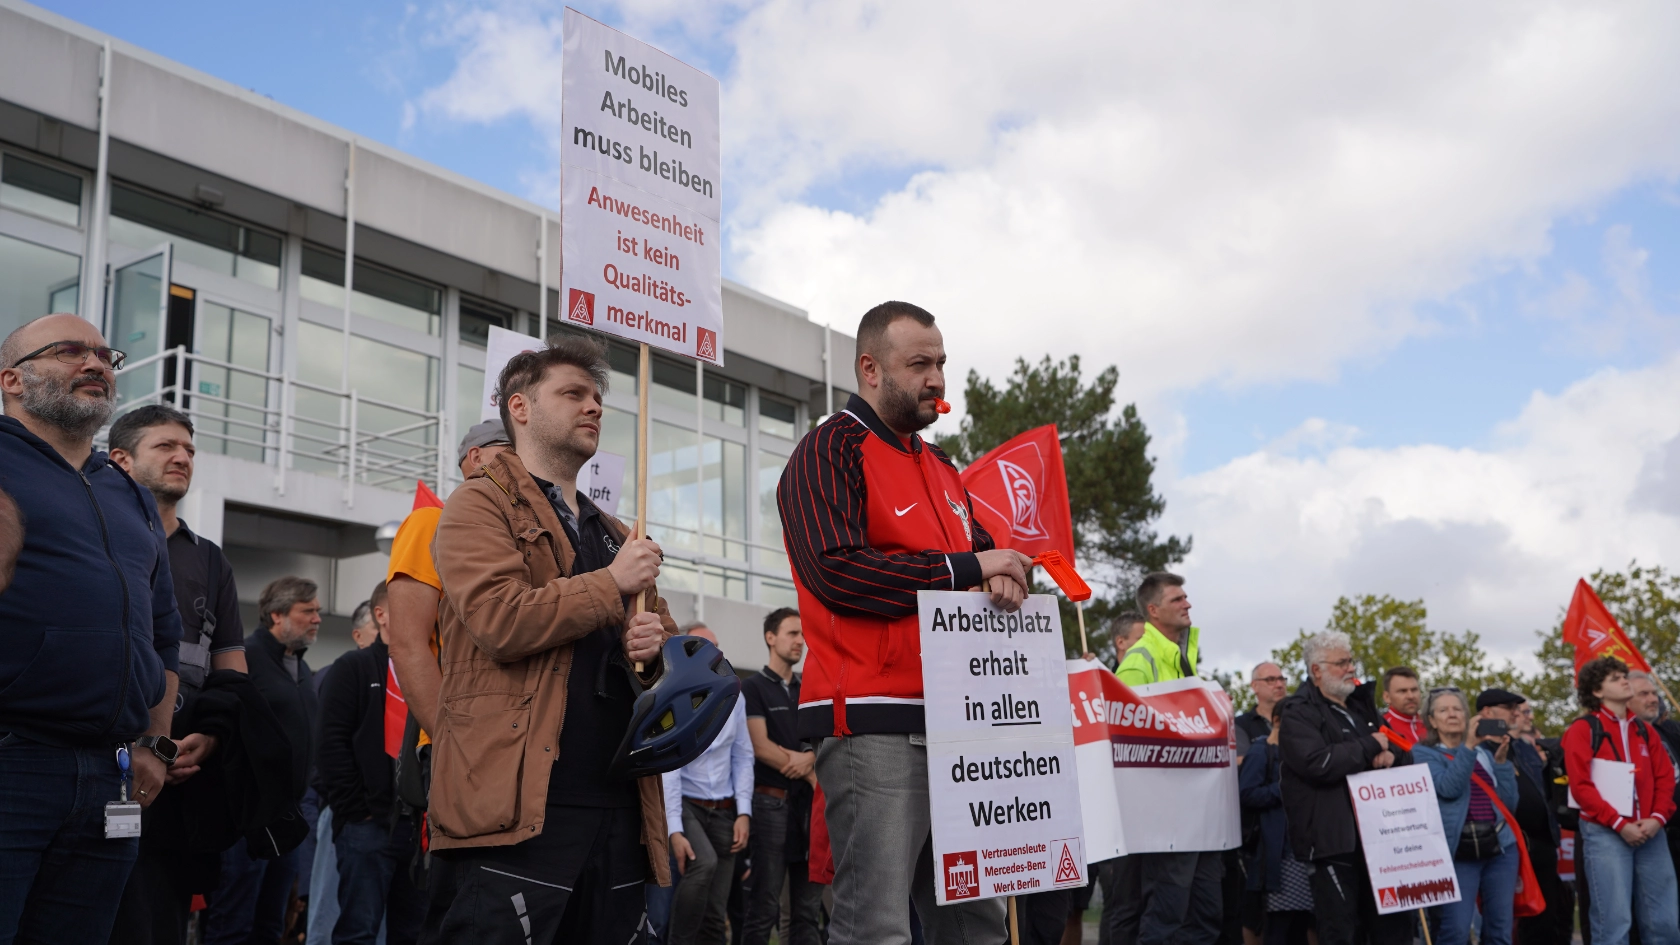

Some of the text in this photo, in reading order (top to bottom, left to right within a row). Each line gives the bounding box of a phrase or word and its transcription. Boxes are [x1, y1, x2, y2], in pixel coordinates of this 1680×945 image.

[604, 49, 688, 108] Mobiles
[600, 90, 692, 149] Arbeiten
[573, 126, 713, 199] muss bleiben
[588, 186, 704, 246] Anwesenheit
[617, 230, 680, 271] ist kein
[603, 263, 692, 307] Qualitäts-
[607, 304, 687, 343] merkmal
[931, 605, 1053, 638] Arbeitsplatz
[969, 649, 1029, 676] erhalt
[965, 694, 1040, 721] in allen
[952, 751, 1060, 783] deutschen
[1113, 743, 1161, 763] ZUKUNFT
[1160, 745, 1195, 763] STATT
[1358, 776, 1429, 801] Ola raus!
[969, 796, 1051, 827] Werken
[1379, 823, 1428, 835] Verantwortung
[981, 843, 1047, 860] Vertrauensleute
[1379, 858, 1444, 874] Fehlentscheidungen
[985, 861, 1047, 877] Mercedes-Benz
[993, 877, 1040, 894] Werk Berlin
